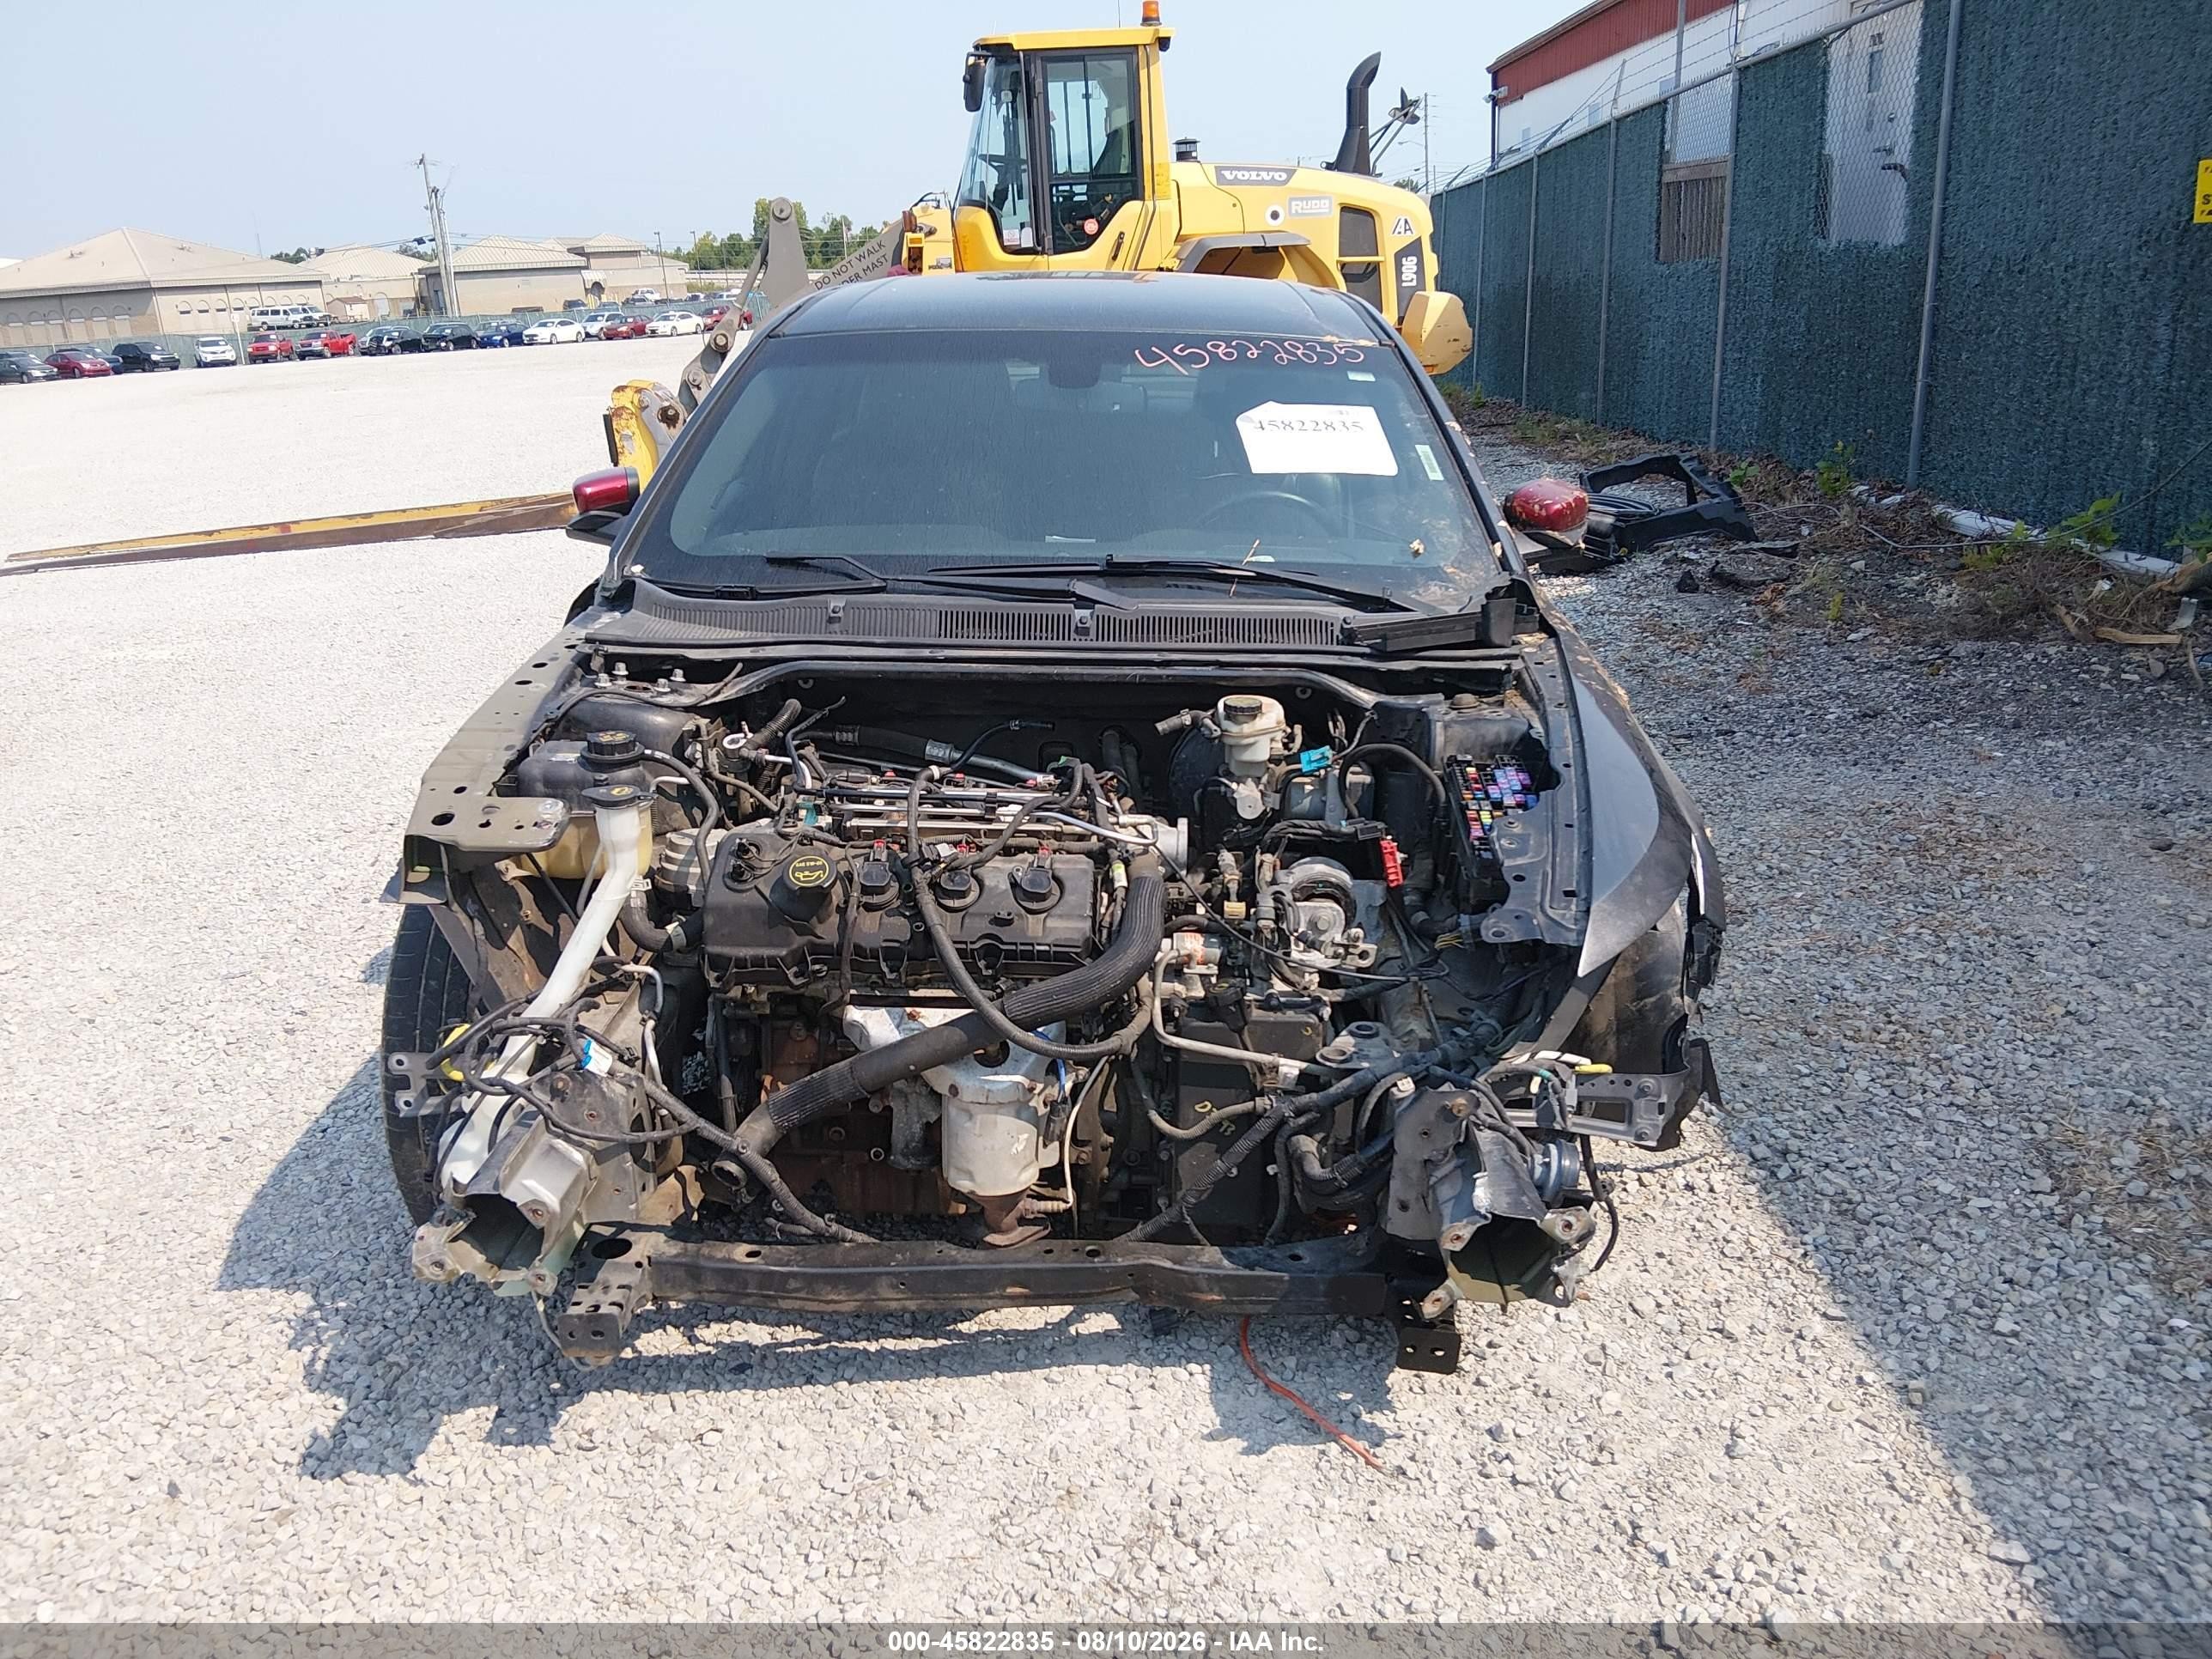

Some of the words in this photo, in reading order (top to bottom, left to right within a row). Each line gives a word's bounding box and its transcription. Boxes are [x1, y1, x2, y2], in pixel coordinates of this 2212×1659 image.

[1221, 170, 1288, 181] VOLVO
[1291, 198, 1330, 215] RUDD
[814, 276, 831, 290] DO
[832, 259, 854, 279] NOT
[855, 240, 886, 263] WALK
[862, 253, 888, 276] MAST
[1134, 341, 1365, 376] 45822835
